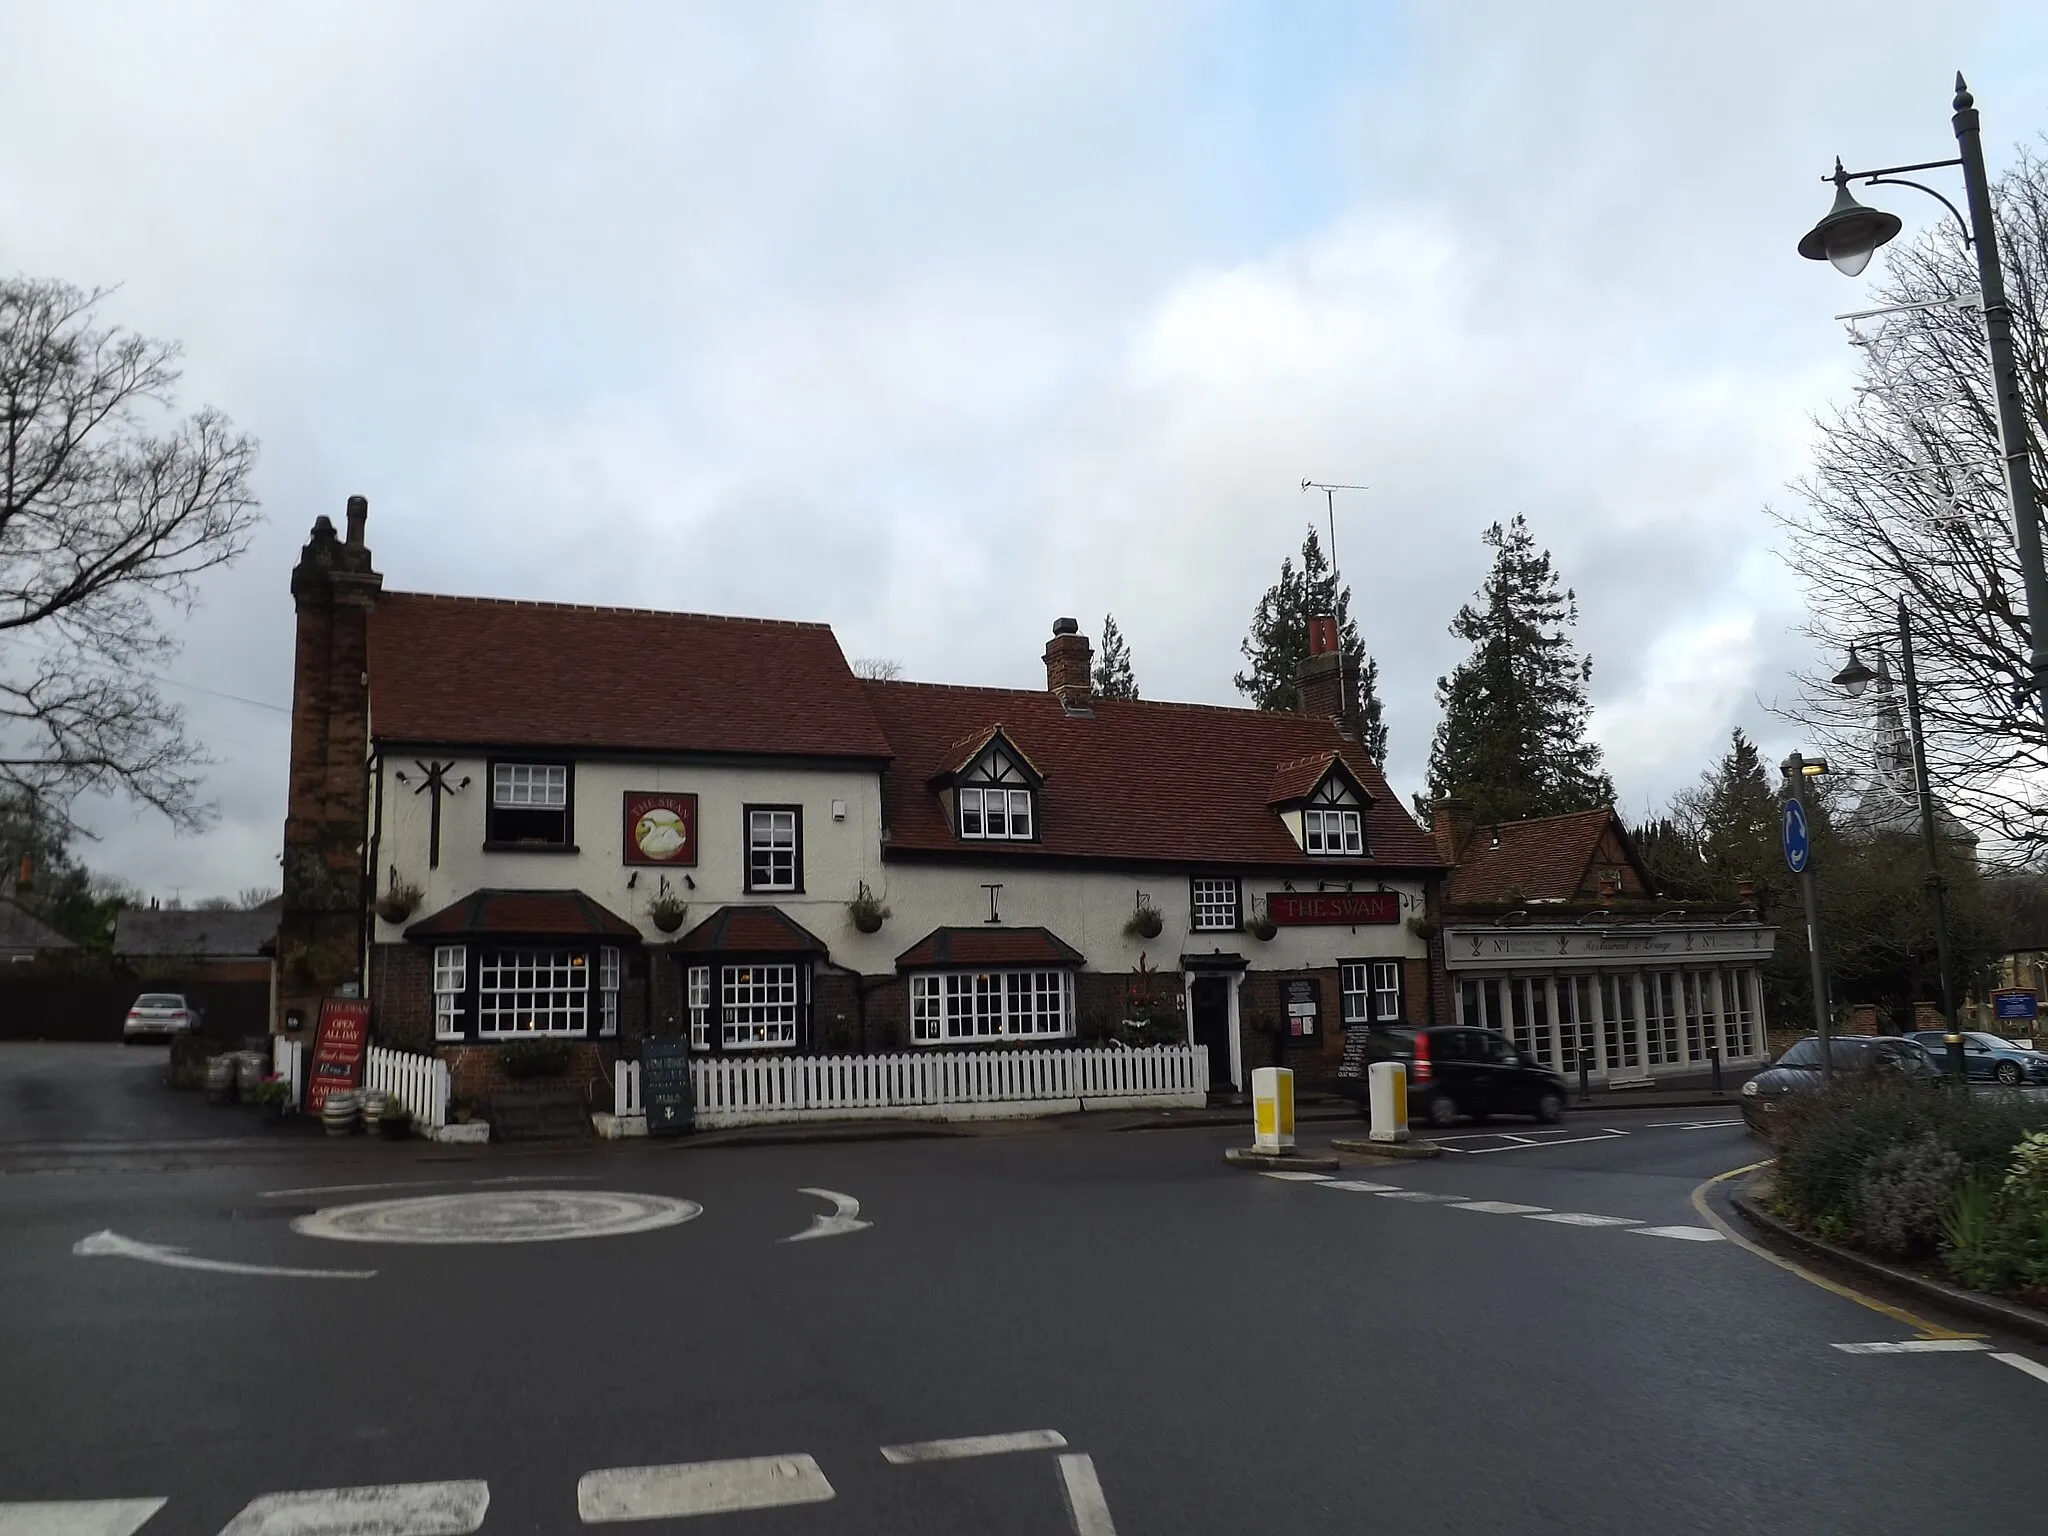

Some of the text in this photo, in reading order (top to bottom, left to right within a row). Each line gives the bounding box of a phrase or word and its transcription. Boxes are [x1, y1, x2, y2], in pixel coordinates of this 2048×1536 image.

[630, 798, 689, 818] THE SWAN
[1284, 898, 1384, 917] THE SWAN
[1583, 940, 1630, 952] Restaurant
[326, 1003, 369, 1014] THE SWAN
[332, 1019, 355, 1029] OPEN
[324, 1030, 360, 1041] ALL DAY
[312, 1084, 329, 1096] CAR
